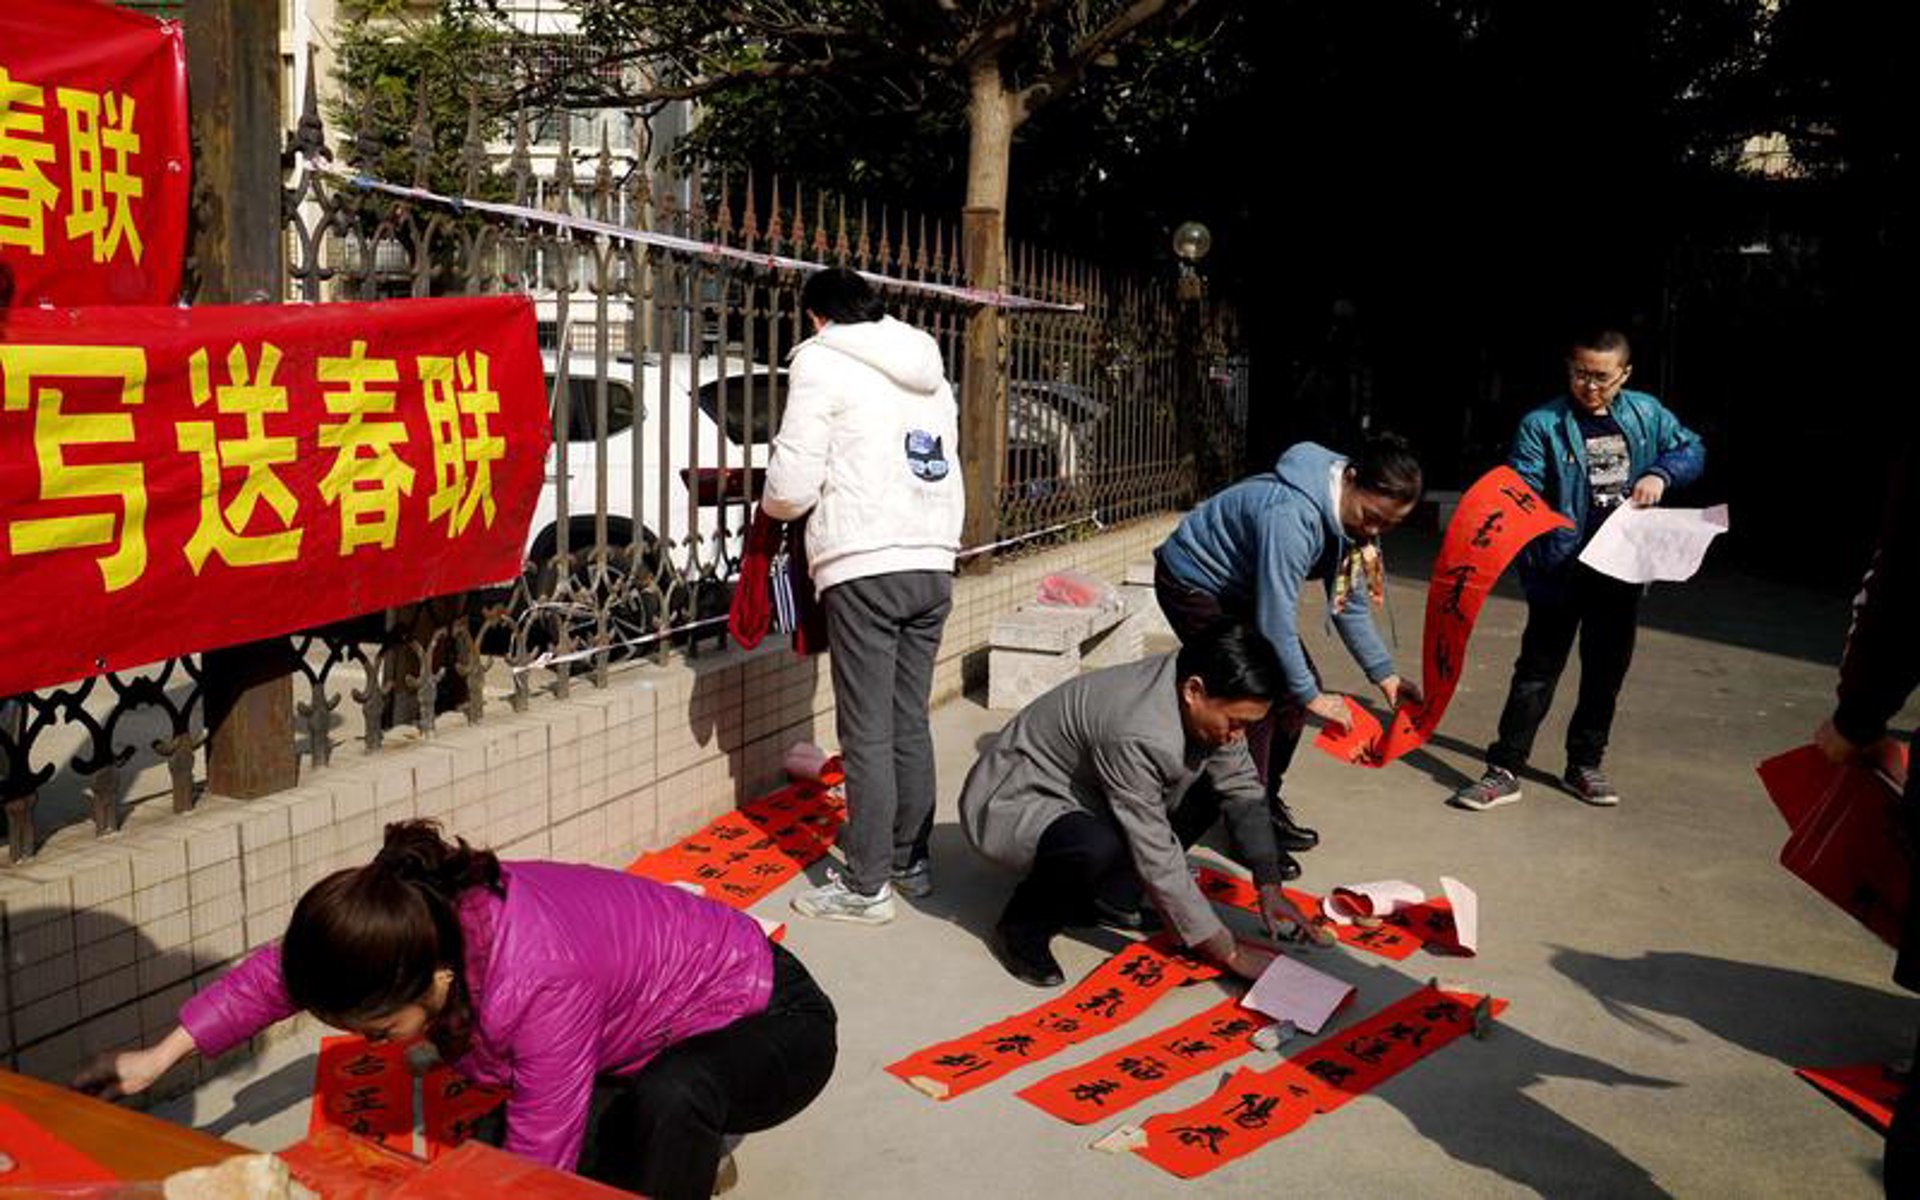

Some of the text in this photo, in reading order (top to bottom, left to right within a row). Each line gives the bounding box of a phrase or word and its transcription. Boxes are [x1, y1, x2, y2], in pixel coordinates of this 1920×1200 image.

[0, 66, 143, 264] 春联
[0, 340, 506, 592] 写送春联
